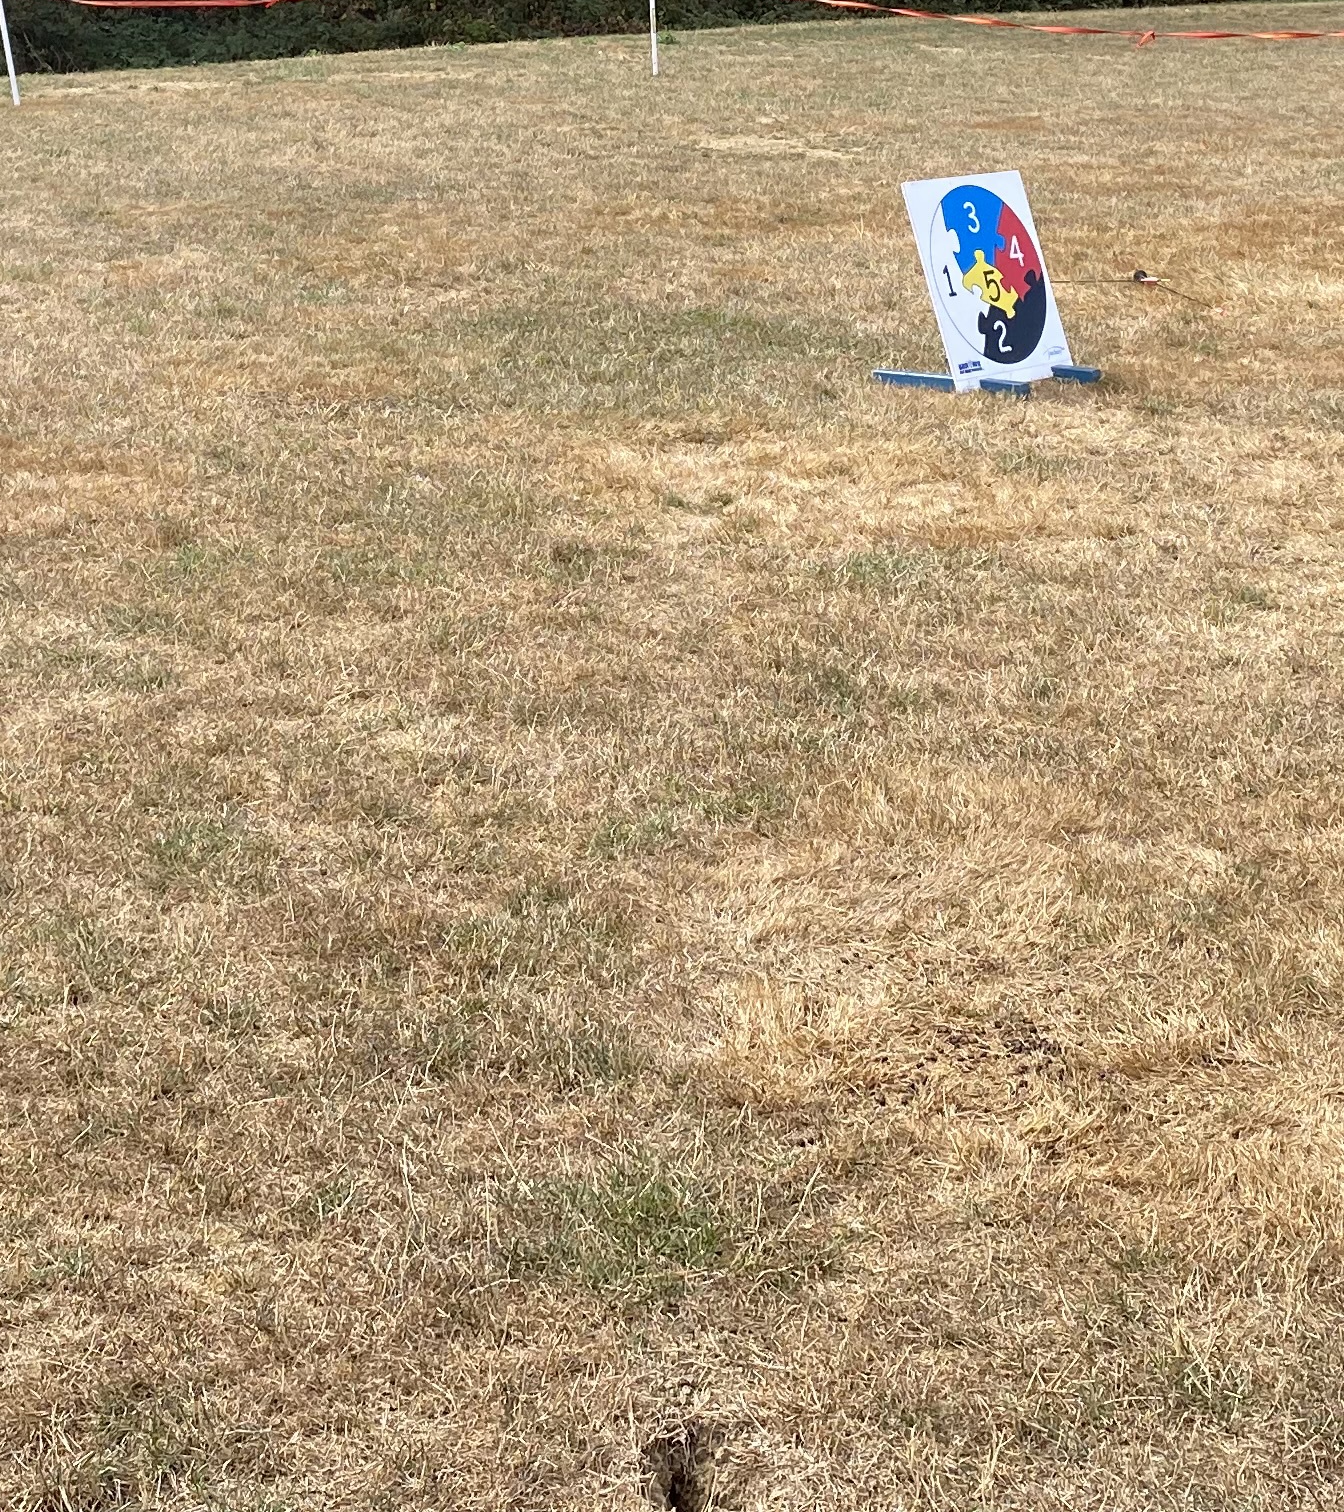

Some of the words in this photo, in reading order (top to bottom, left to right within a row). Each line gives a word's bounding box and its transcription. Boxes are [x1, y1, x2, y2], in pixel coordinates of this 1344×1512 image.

[963, 201, 980, 233] 3
[1009, 235, 1024, 267] 4
[942, 265, 957, 297] 1
[983, 270, 1001, 302] 5
[993, 320, 1012, 353] 2
